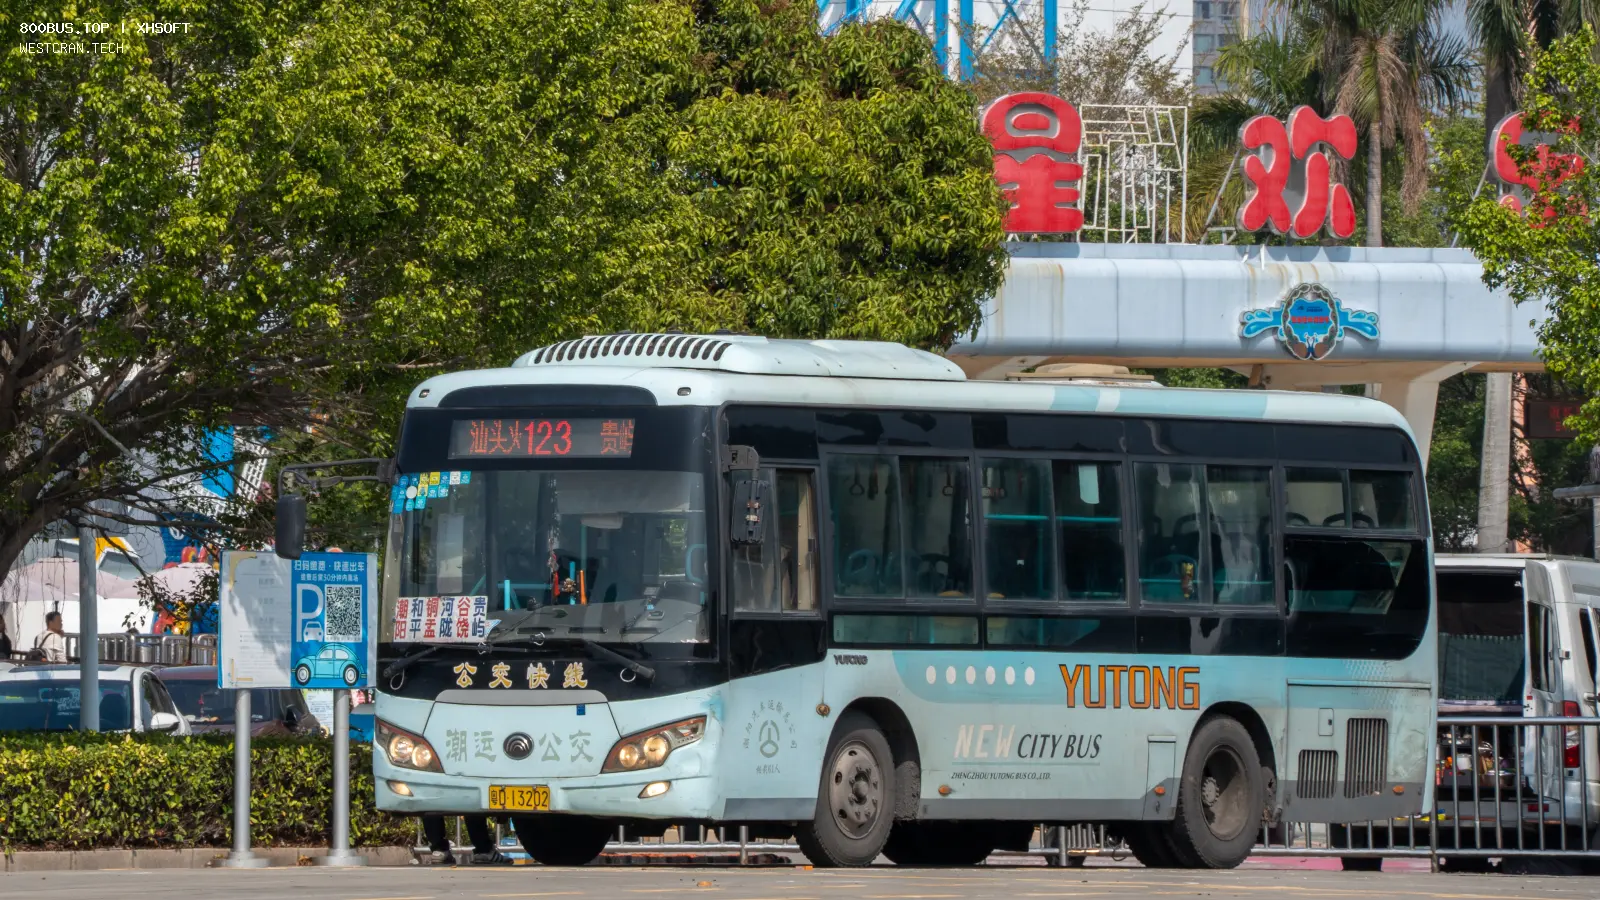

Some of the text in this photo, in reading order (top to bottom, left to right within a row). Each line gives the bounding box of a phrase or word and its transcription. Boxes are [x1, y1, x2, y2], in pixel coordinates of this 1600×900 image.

[524, 420, 572, 455] 123
[453, 662, 588, 689] 公交快线
[833, 654, 868, 666] YUTONG
[1058, 664, 1200, 710] YUTONG
[538, 729, 594, 763] 公交
[954, 724, 1102, 759] NEW CITY BUS
[951, 772, 989, 780] ZHENGZHOU
[989, 772, 1015, 780] YUTONG
[1015, 772, 1027, 780] BUS
